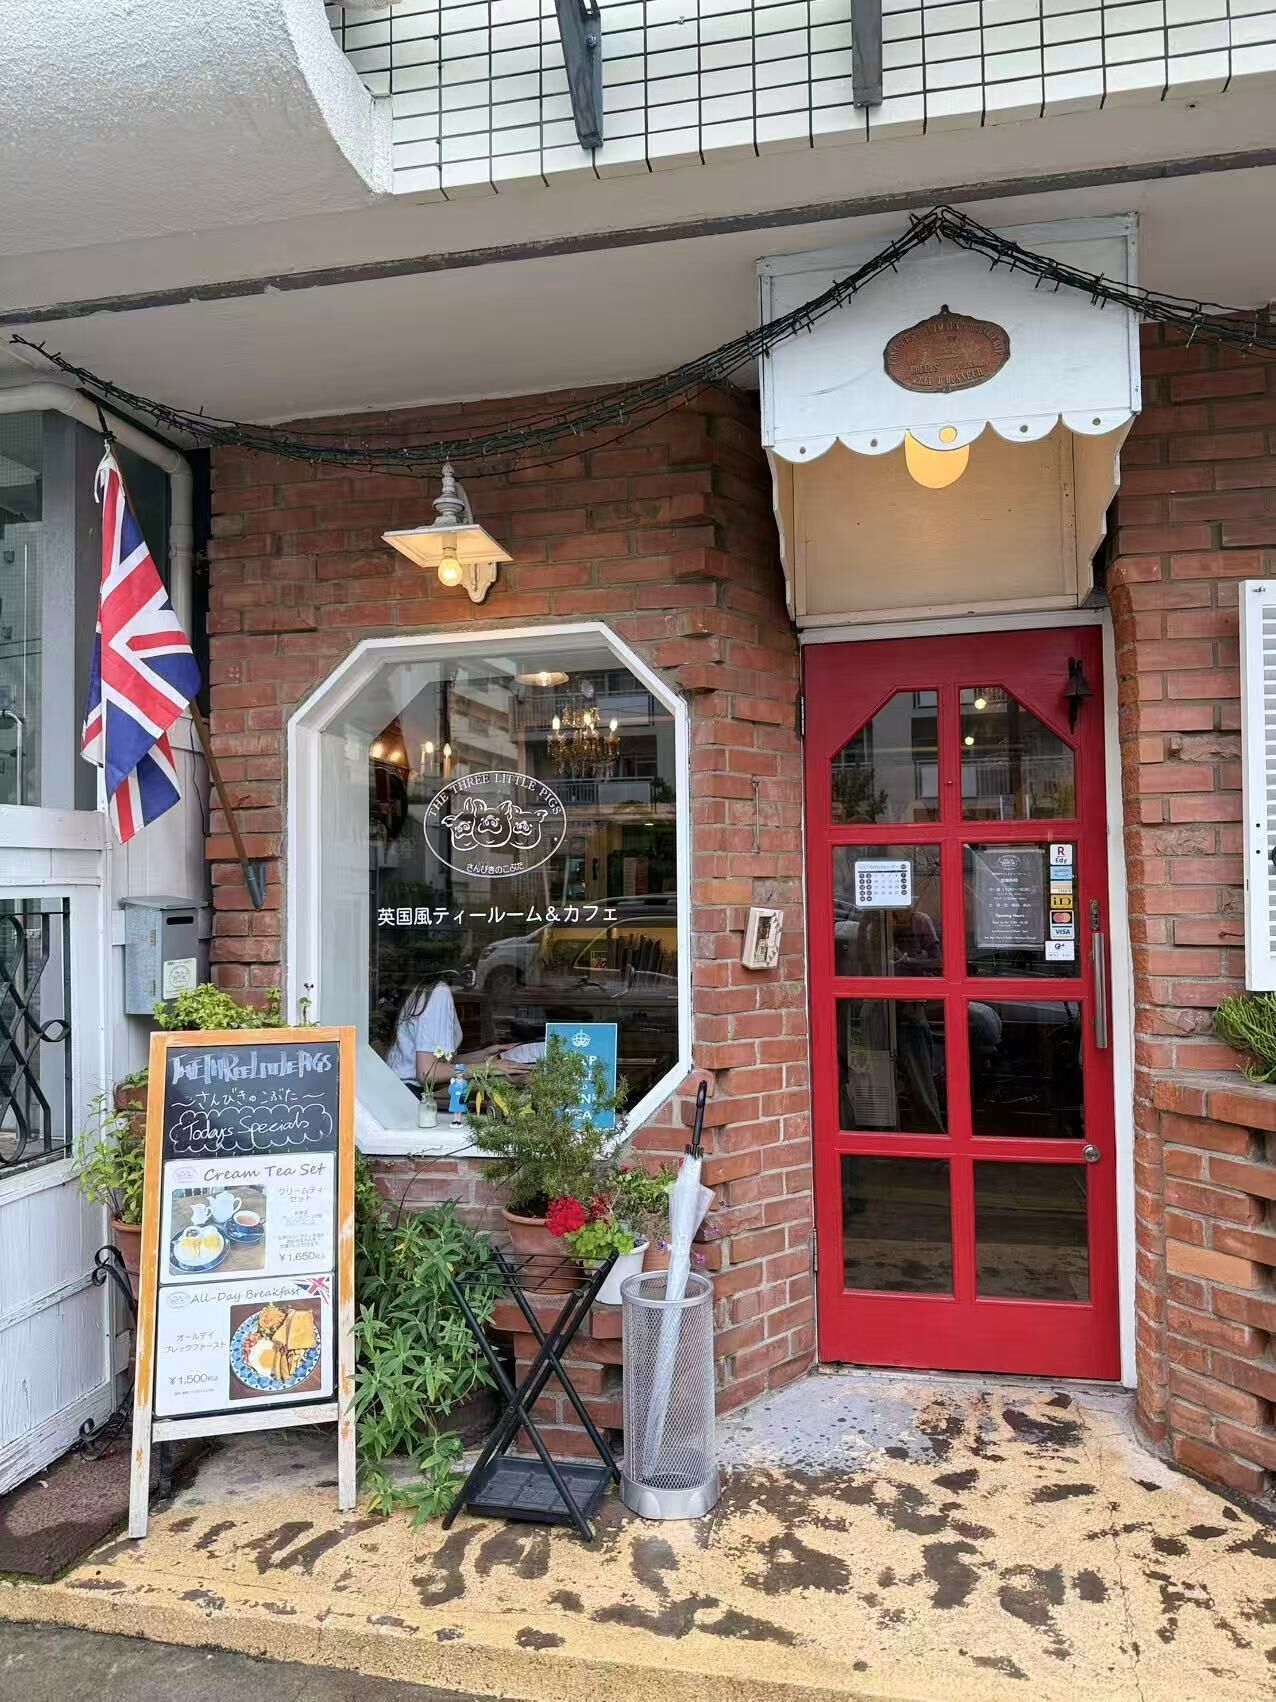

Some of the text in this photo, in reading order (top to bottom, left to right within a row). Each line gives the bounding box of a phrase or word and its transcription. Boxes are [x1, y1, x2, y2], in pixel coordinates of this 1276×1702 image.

[428, 773, 562, 818] THE THREE LITTLE PIGS
[466, 861, 525, 875] さんびきのこぶた
[1055, 857, 1068, 865] Edy
[238, 1112, 309, 1147] Specials
[204, 1163, 326, 1181] Cream Tea Set
[190, 1286, 302, 1304] All-Day Breakfast
